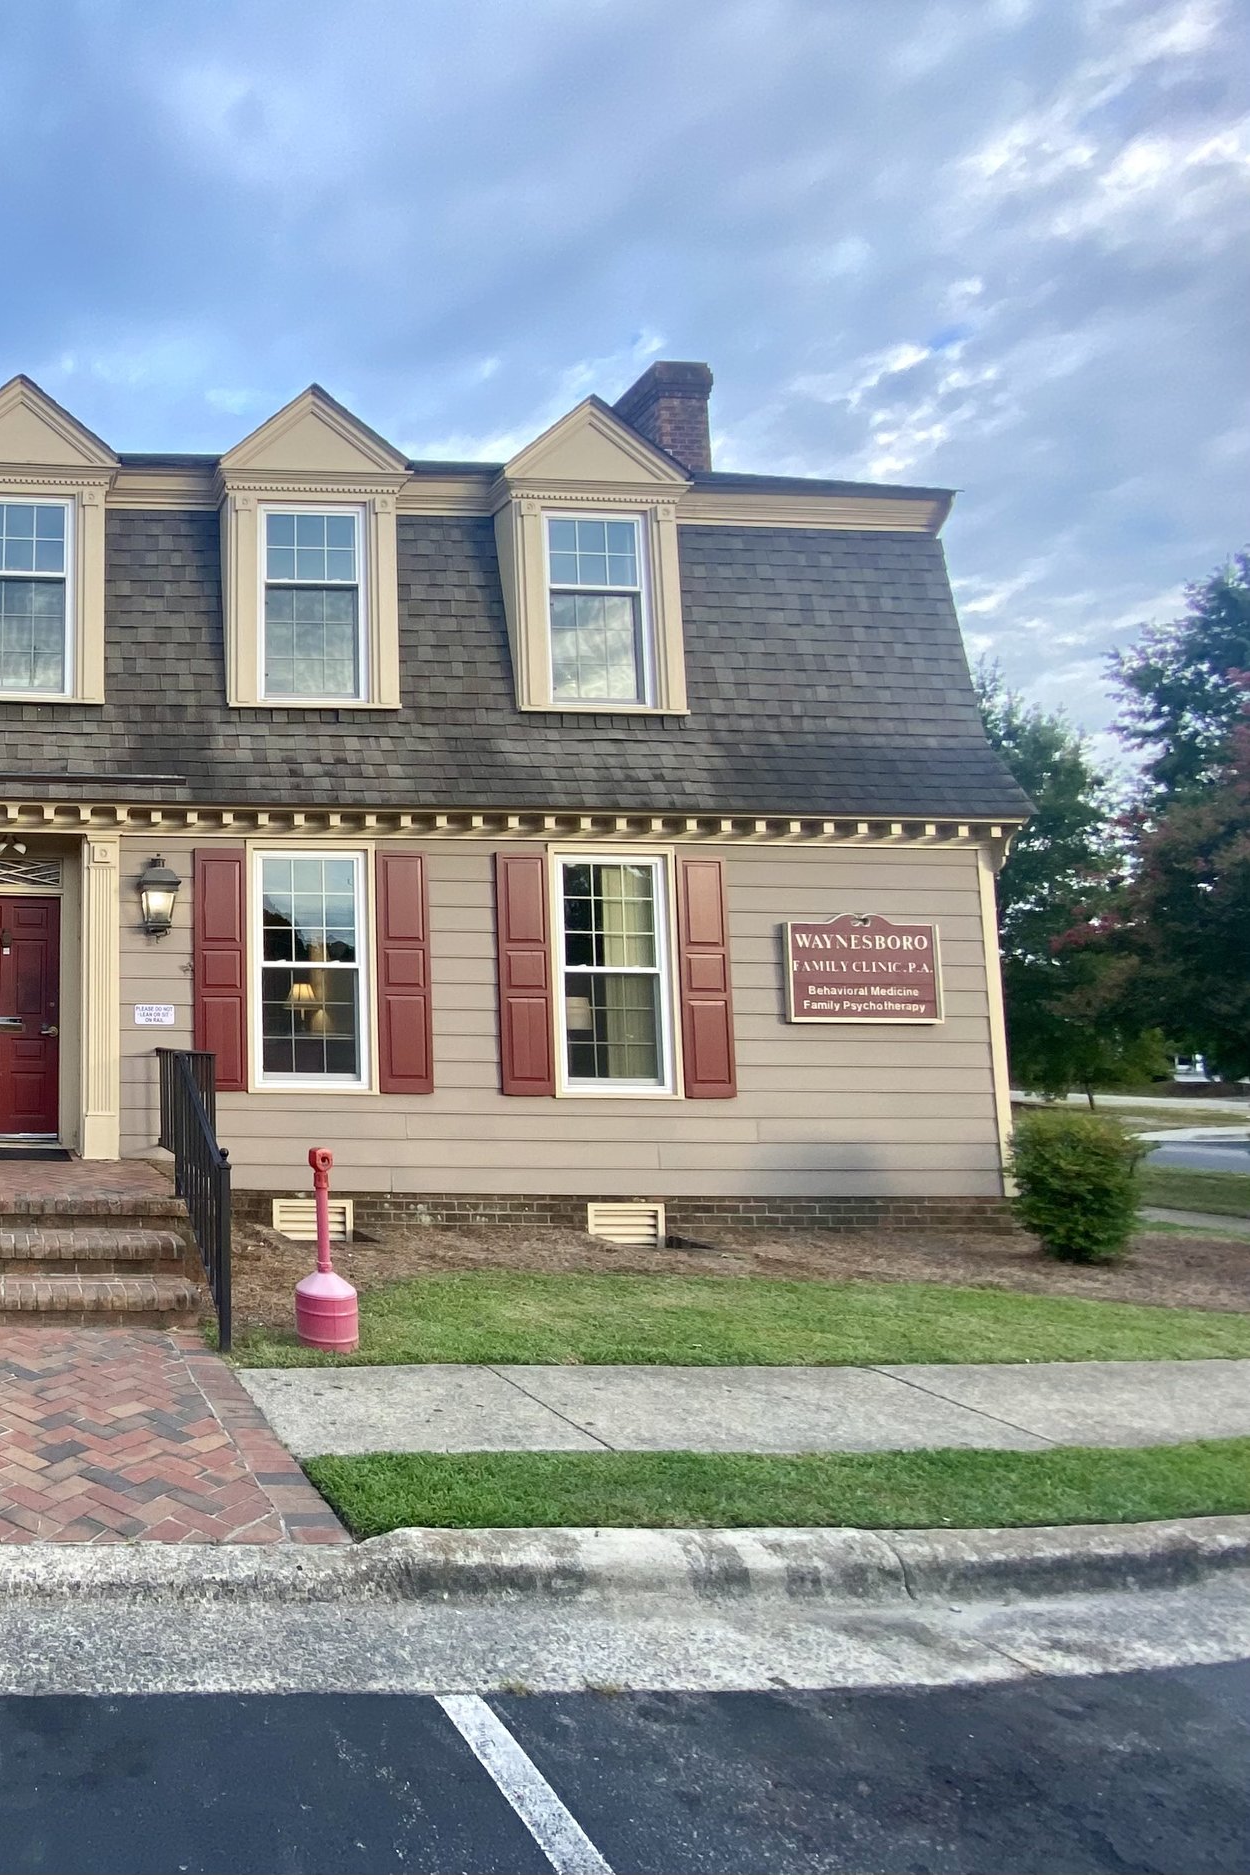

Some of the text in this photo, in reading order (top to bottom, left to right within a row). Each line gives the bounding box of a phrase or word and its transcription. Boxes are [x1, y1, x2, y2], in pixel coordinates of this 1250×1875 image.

[794, 933, 928, 951] WAYNESBORO
[793, 960, 849, 973] FAMILY
[808, 985, 919, 997] Behavioral Medicine
[803, 1000, 926, 1014] Family Psychotherapy
